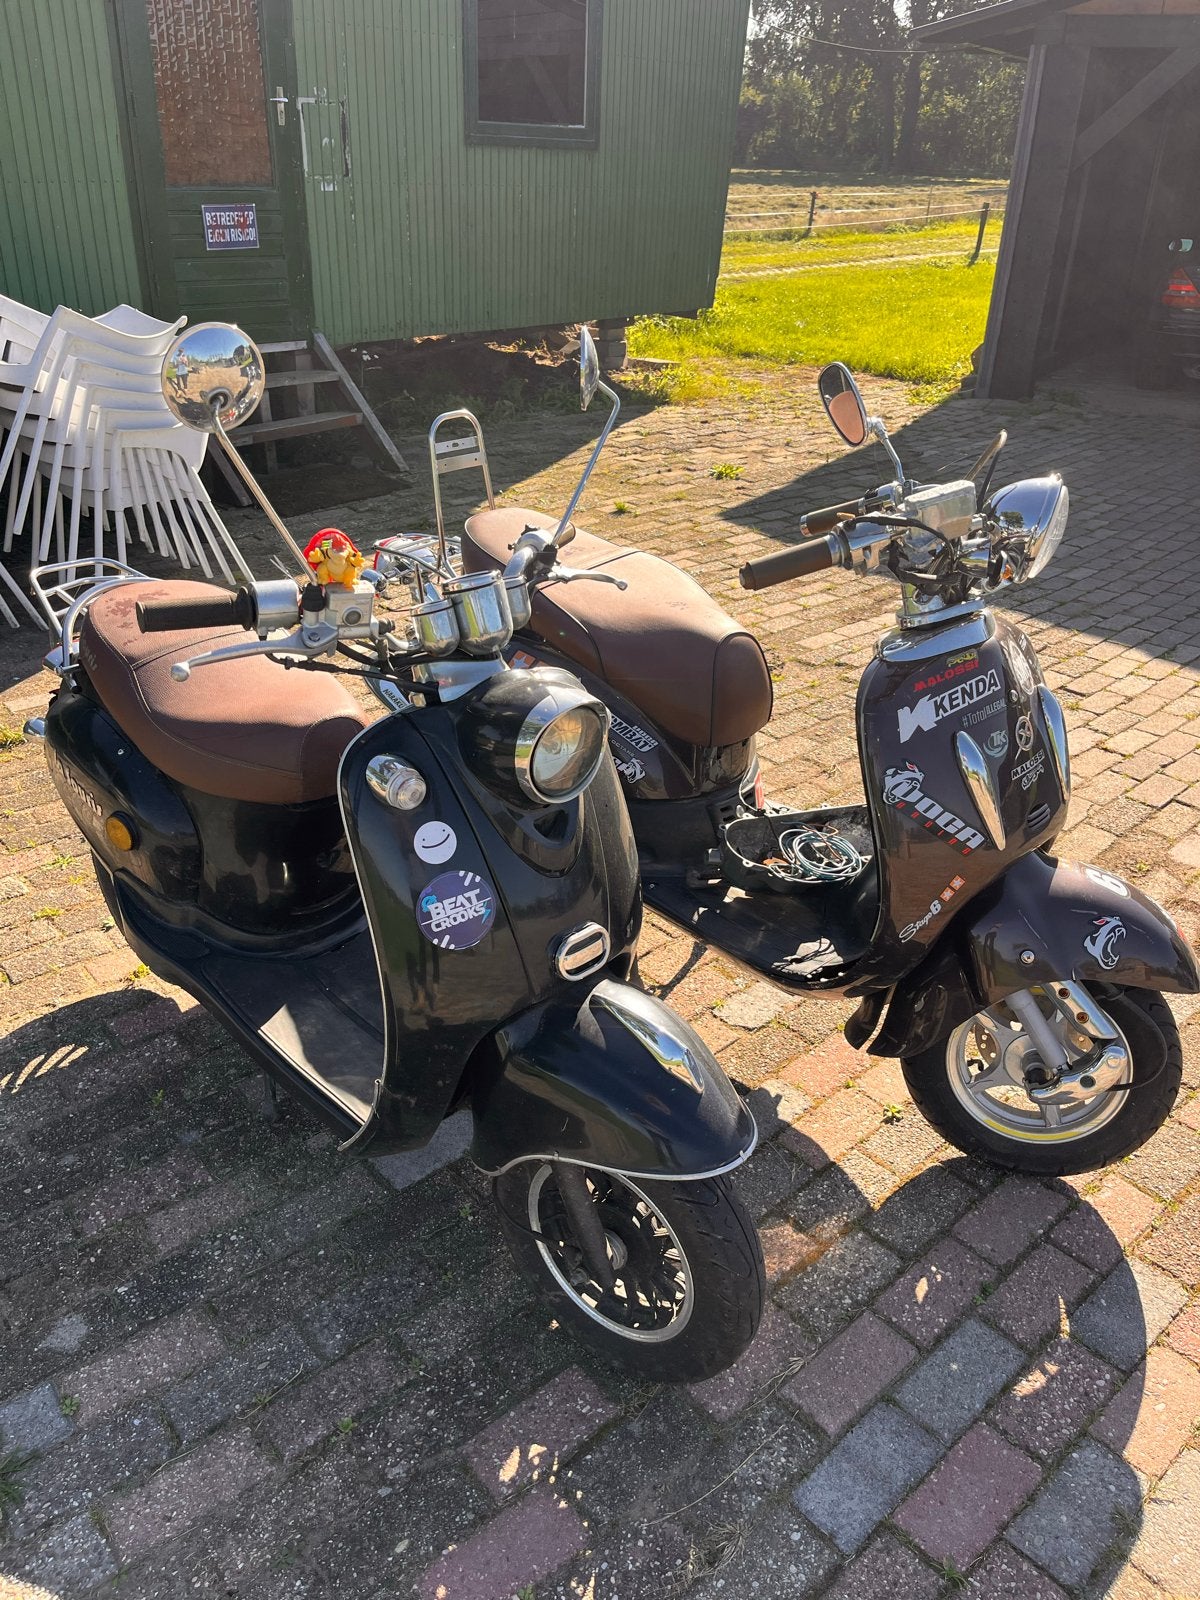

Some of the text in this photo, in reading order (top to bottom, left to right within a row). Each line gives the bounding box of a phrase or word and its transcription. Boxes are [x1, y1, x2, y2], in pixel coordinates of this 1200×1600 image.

[913, 659, 980, 692] MALOSSI
[932, 668, 1001, 722] KENDA
[427, 888, 480, 921] BEAT
[430, 902, 486, 932] CROOKS
